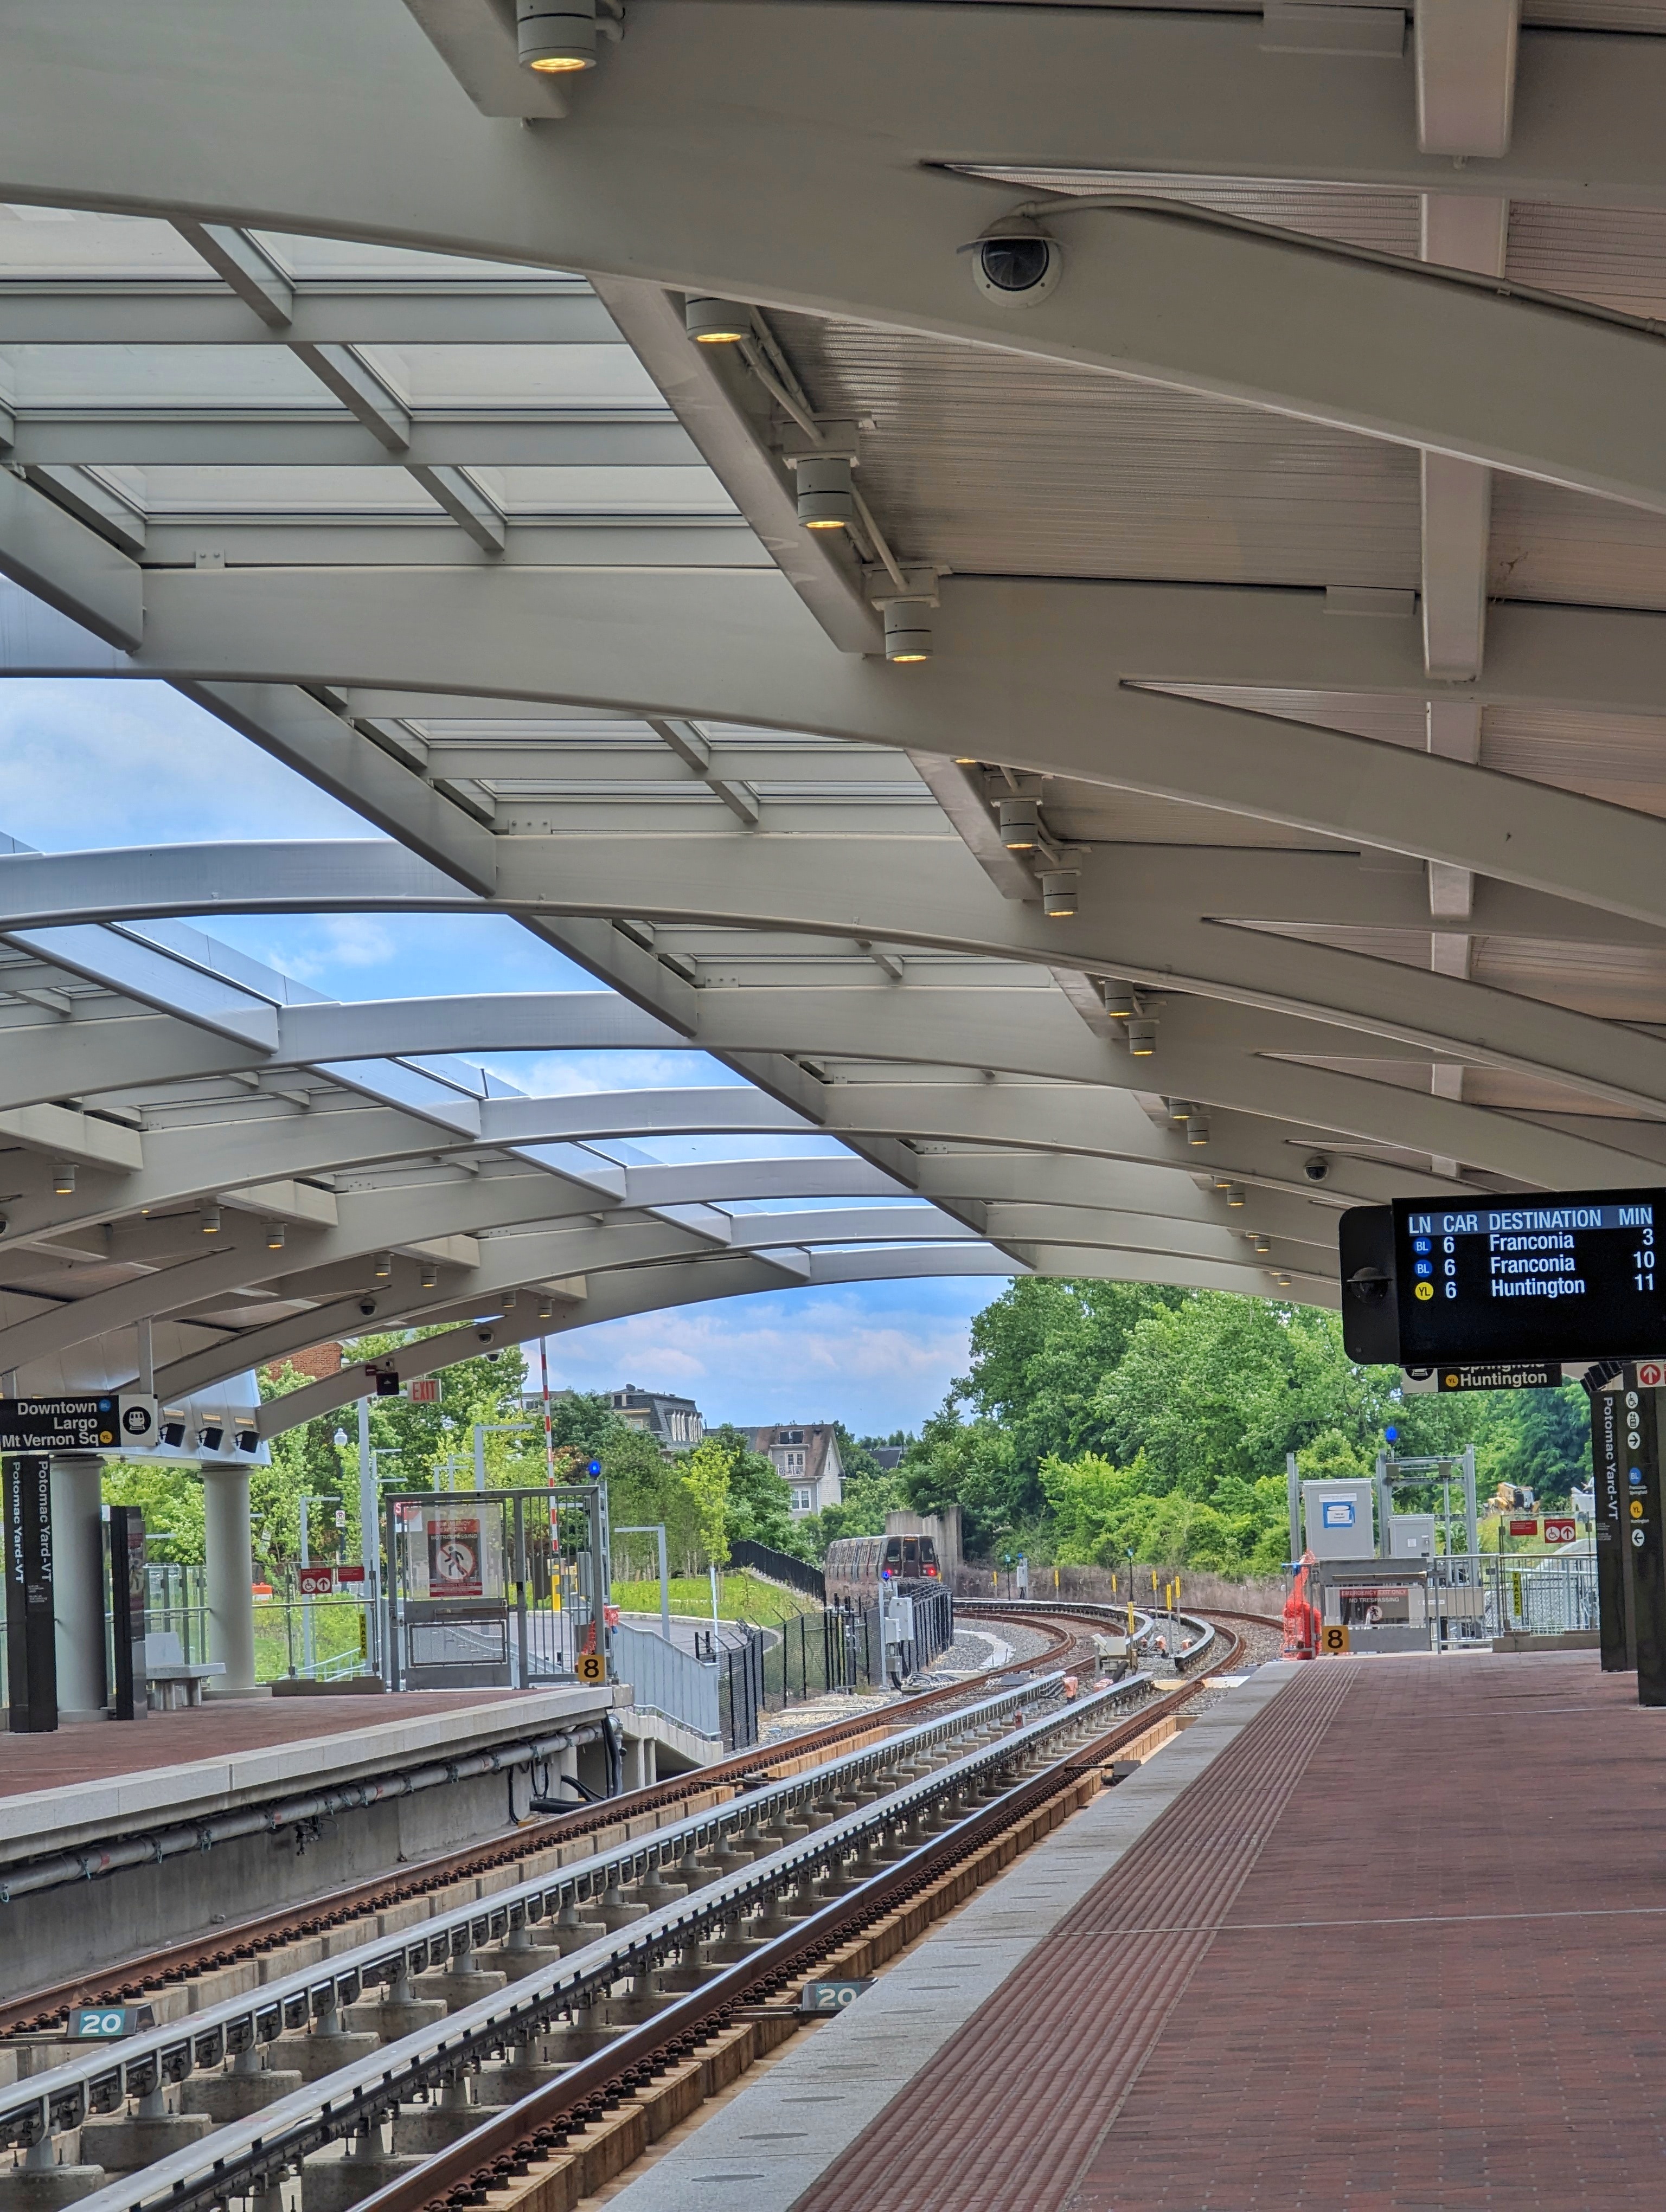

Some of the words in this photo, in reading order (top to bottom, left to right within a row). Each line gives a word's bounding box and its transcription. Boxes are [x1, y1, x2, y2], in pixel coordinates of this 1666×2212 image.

[1409, 1216, 1432, 1233] LN
[1443, 1214, 1478, 1232] CAR
[1489, 1210, 1601, 1231] DESTINATION
[1619, 1207, 1652, 1225] MIN
[1416, 1242, 1428, 1251] BL
[1443, 1236, 1454, 1253] 6
[1490, 1231, 1575, 1252] Franconia
[1643, 1229, 1654, 1245] 3
[1417, 1264, 1430, 1274] BL
[1444, 1259, 1456, 1276] 6
[1491, 1254, 1575, 1274] Franconia
[1633, 1251, 1655, 1269] 10
[1418, 1287, 1431, 1296] YL
[1445, 1281, 1457, 1298] 6
[1491, 1277, 1585, 1298] Huntington
[1635, 1274, 1654, 1291] 11
[412, 1380, 435, 1400] EXIT
[1460, 1372, 1548, 1387] Huntington
[17, 1401, 97, 1416] Downtown
[54, 1417, 98, 1432] Largo
[1604, 1397, 1614, 1461] Potomac
[2, 1435, 21, 1448] Mt
[24, 1434, 74, 1447] Vernon
[79, 1432, 99, 1446] Sq
[12, 1462, 21, 1524] Potomac
[39, 1461, 49, 1523] Potomac
[1606, 1462, 1618, 1520] Yard-VT
[14, 1526, 24, 1584] Yard-VT
[40, 1525, 52, 1582] Yard-VT
[1328, 1629, 1343, 1649] 8
[584, 1658, 599, 1678] 8
[818, 1988, 857, 2007] 20
[81, 2014, 121, 2034] 20
